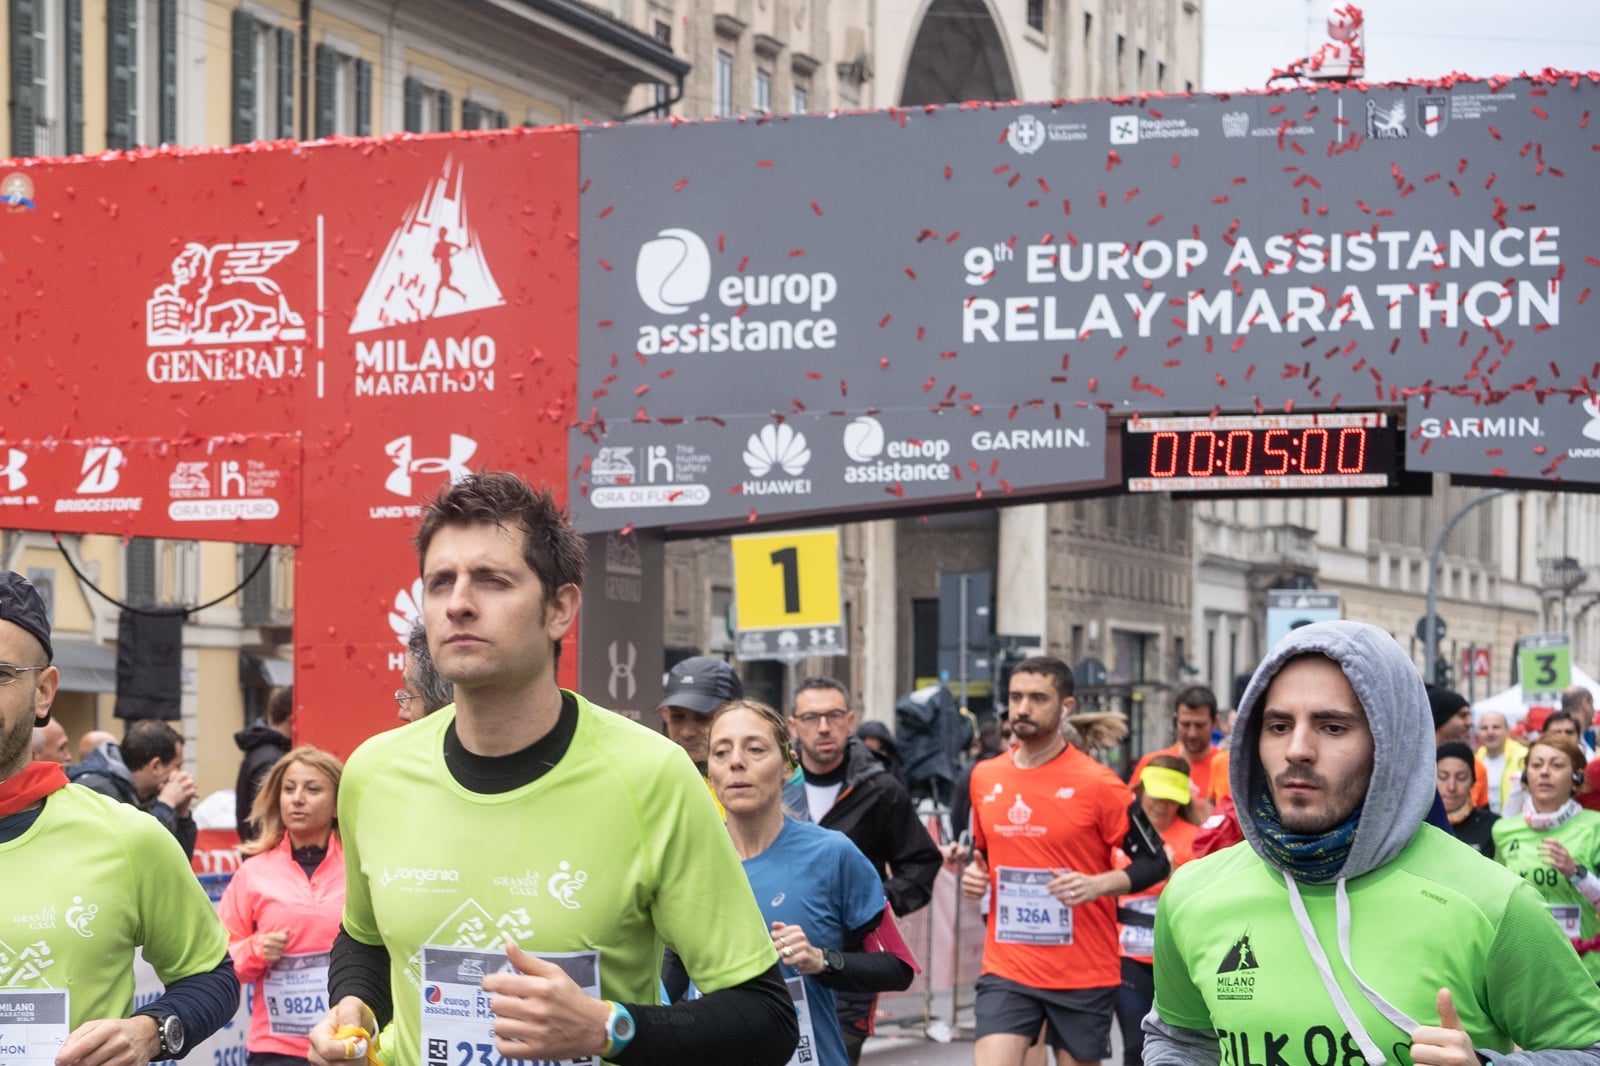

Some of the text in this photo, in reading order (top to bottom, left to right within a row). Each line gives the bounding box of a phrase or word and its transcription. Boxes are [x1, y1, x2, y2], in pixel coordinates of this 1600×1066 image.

[963, 226, 1560, 286] 9th EUROP ASSISTANCE
[719, 272, 837, 311] europ
[963, 279, 1560, 343] RELAY MARATHON
[636, 313, 837, 355] assistance
[355, 335, 496, 373] MILANO
[355, 369, 495, 397] MARATHON
[1420, 417, 1541, 438] GARMIN
[972, 428, 1086, 452] GARMIN
[887, 438, 950, 465] europ
[1150, 427, 1366, 477] 00:05:00
[843, 457, 950, 483] assistance
[647, 489, 706, 502] FURO
[743, 479, 811, 495] HUAWEI
[54, 497, 143, 513] BRIDGESTONE
[769, 546, 801, 615] 1
[1534, 654, 1557, 686] 3
[390, 868, 460, 886] sorgenia
[493, 877, 539, 888] GRANDE
[1533, 868, 1558, 886] 08
[509, 886, 539, 897] CASA
[13, 914, 57, 924] GRANDE
[29, 922, 57, 931] CASA
[1016, 908, 1051, 924] 326A
[1217, 977, 1256, 987] MILANO
[284, 995, 326, 1014] 982A
